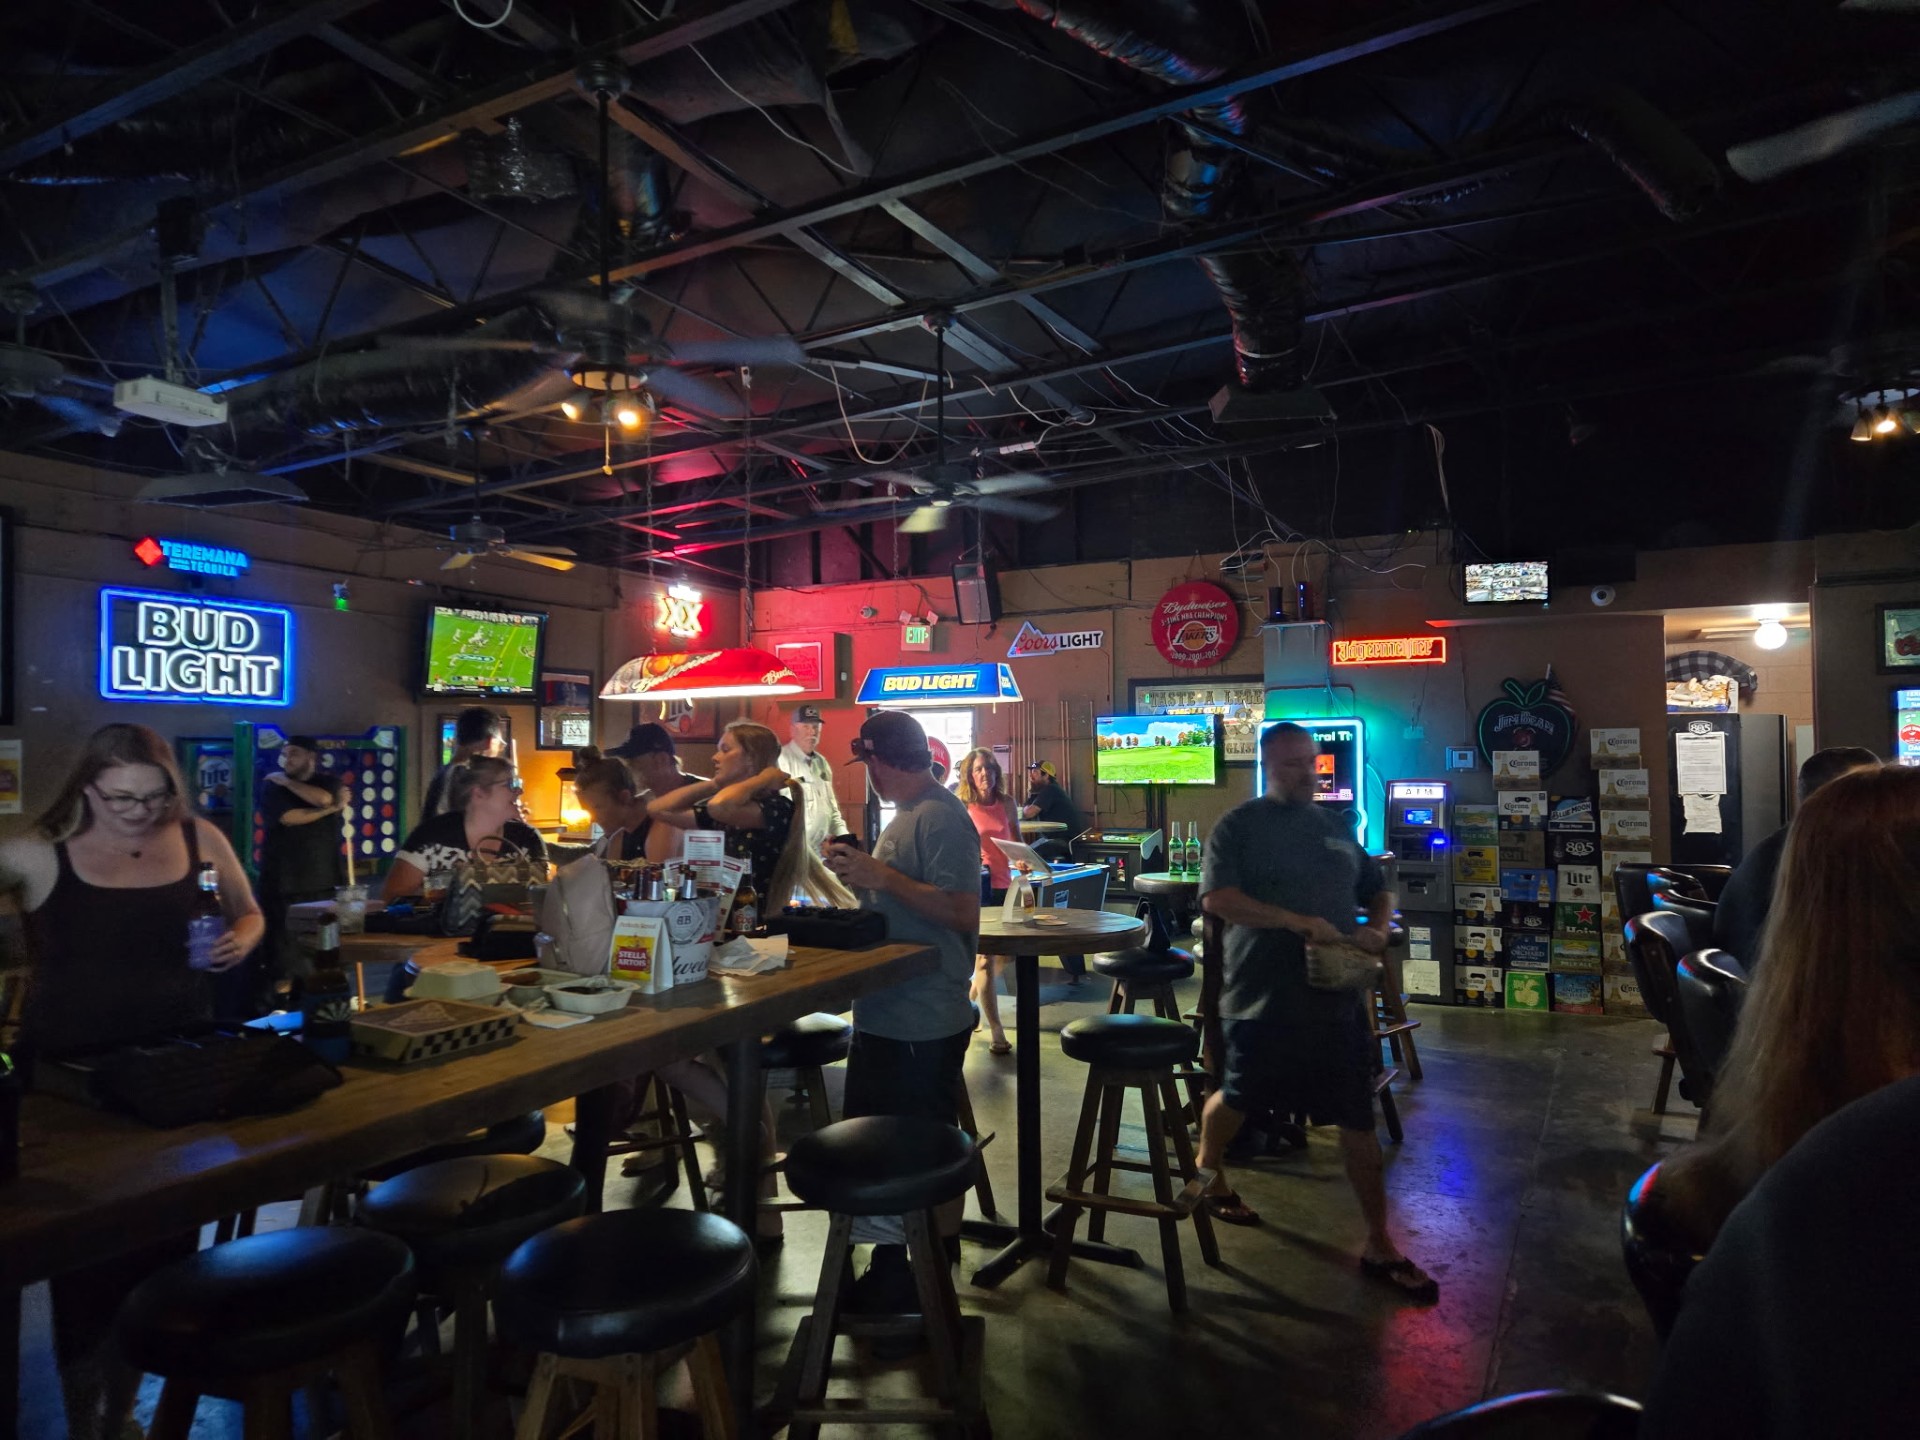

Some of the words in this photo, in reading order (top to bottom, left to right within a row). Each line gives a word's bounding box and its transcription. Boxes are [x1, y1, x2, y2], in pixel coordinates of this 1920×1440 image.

[160, 540, 248, 568] TEREMANA
[190, 560, 238, 577] TEQUILA
[1161, 600, 1228, 615] Budweiser
[1181, 612, 1193, 621] NBA
[1194, 611, 1228, 621] CHAMPIONS
[138, 602, 260, 652] BUD
[906, 627, 926, 644] EXIT
[1017, 633, 1060, 650] Coors
[1060, 633, 1101, 648] LIGHT
[112, 645, 280, 696] LIGHT
[884, 676, 923, 692] BUD
[923, 674, 977, 690] LIGHT
[1150, 690, 1196, 708] TASTE
[1204, 690, 1215, 706] A
[1689, 722, 1712, 733] 805
[1607, 738, 1638, 746] Corona
[1509, 760, 1538, 768] Corona
[1616, 778, 1647, 787] Corona
[1504, 802, 1530, 811] Corona
[1551, 808, 1571, 821] BLUE
[1571, 802, 1592, 814] MOON
[1617, 819, 1648, 828] Corona
[1565, 842, 1595, 854] 805
[1567, 872, 1592, 887] Lite
[618, 950, 647, 959] STELLA
[617, 958, 647, 967] ARTOIS
